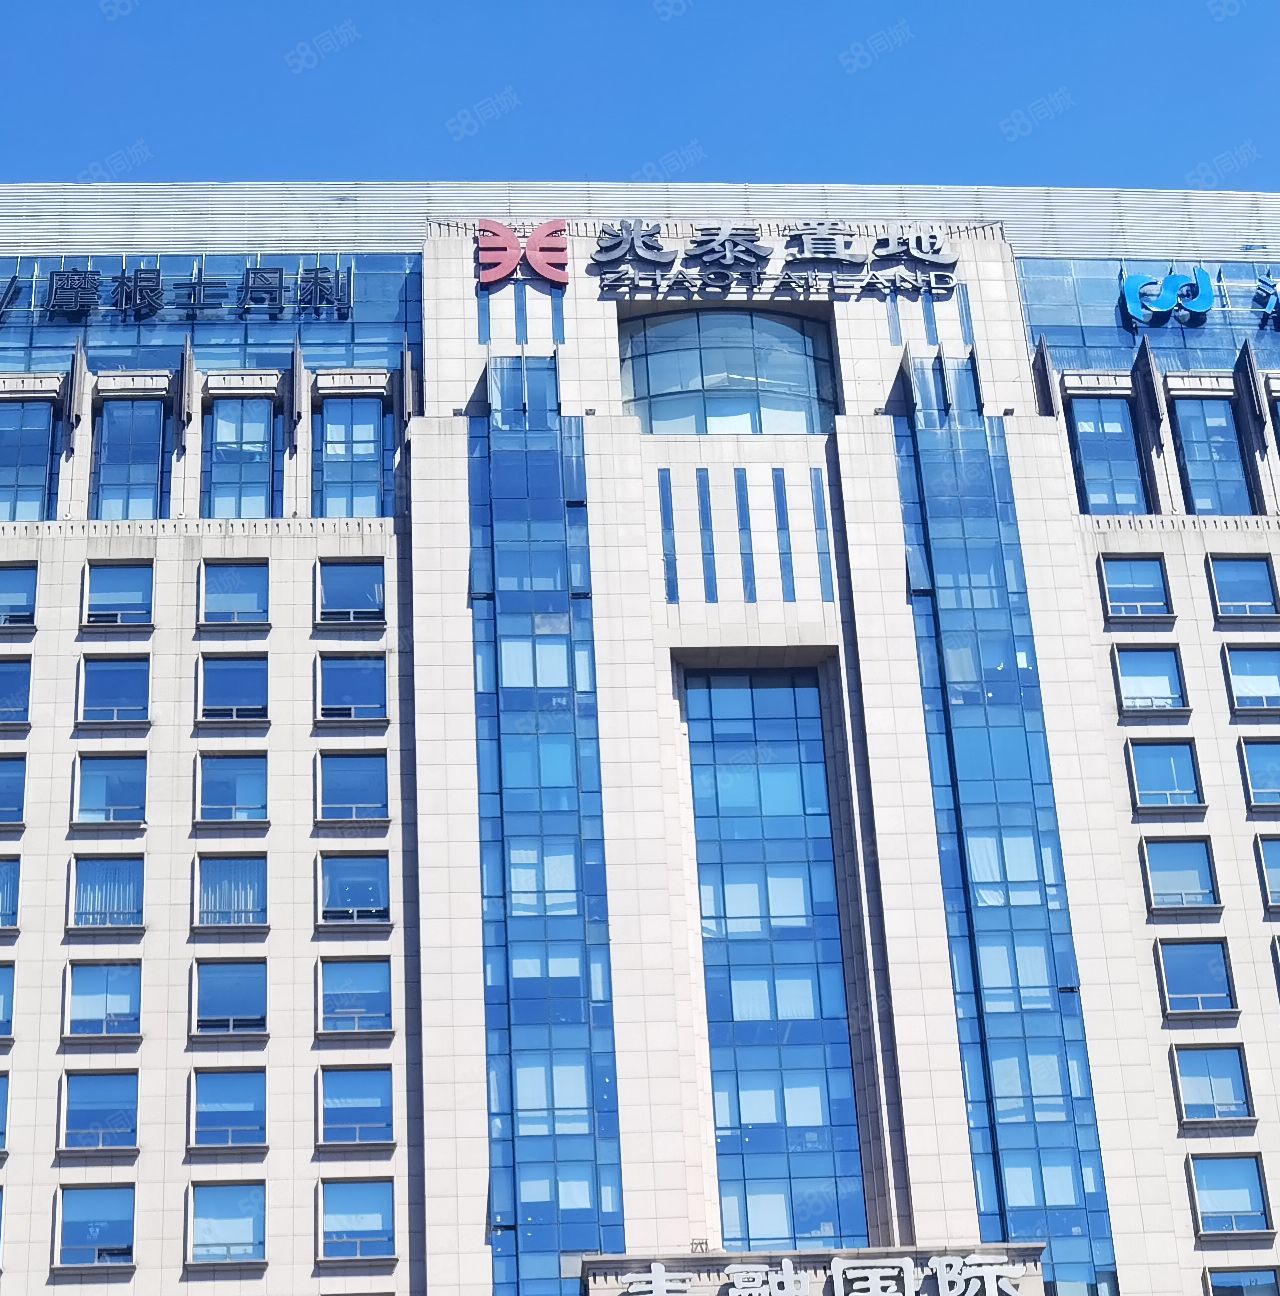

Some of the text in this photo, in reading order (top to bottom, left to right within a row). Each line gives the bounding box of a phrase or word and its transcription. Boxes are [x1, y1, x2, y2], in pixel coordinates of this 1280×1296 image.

[590, 218, 960, 266] 兆泰置地
[45, 266, 353, 312] 摩根士丹利
